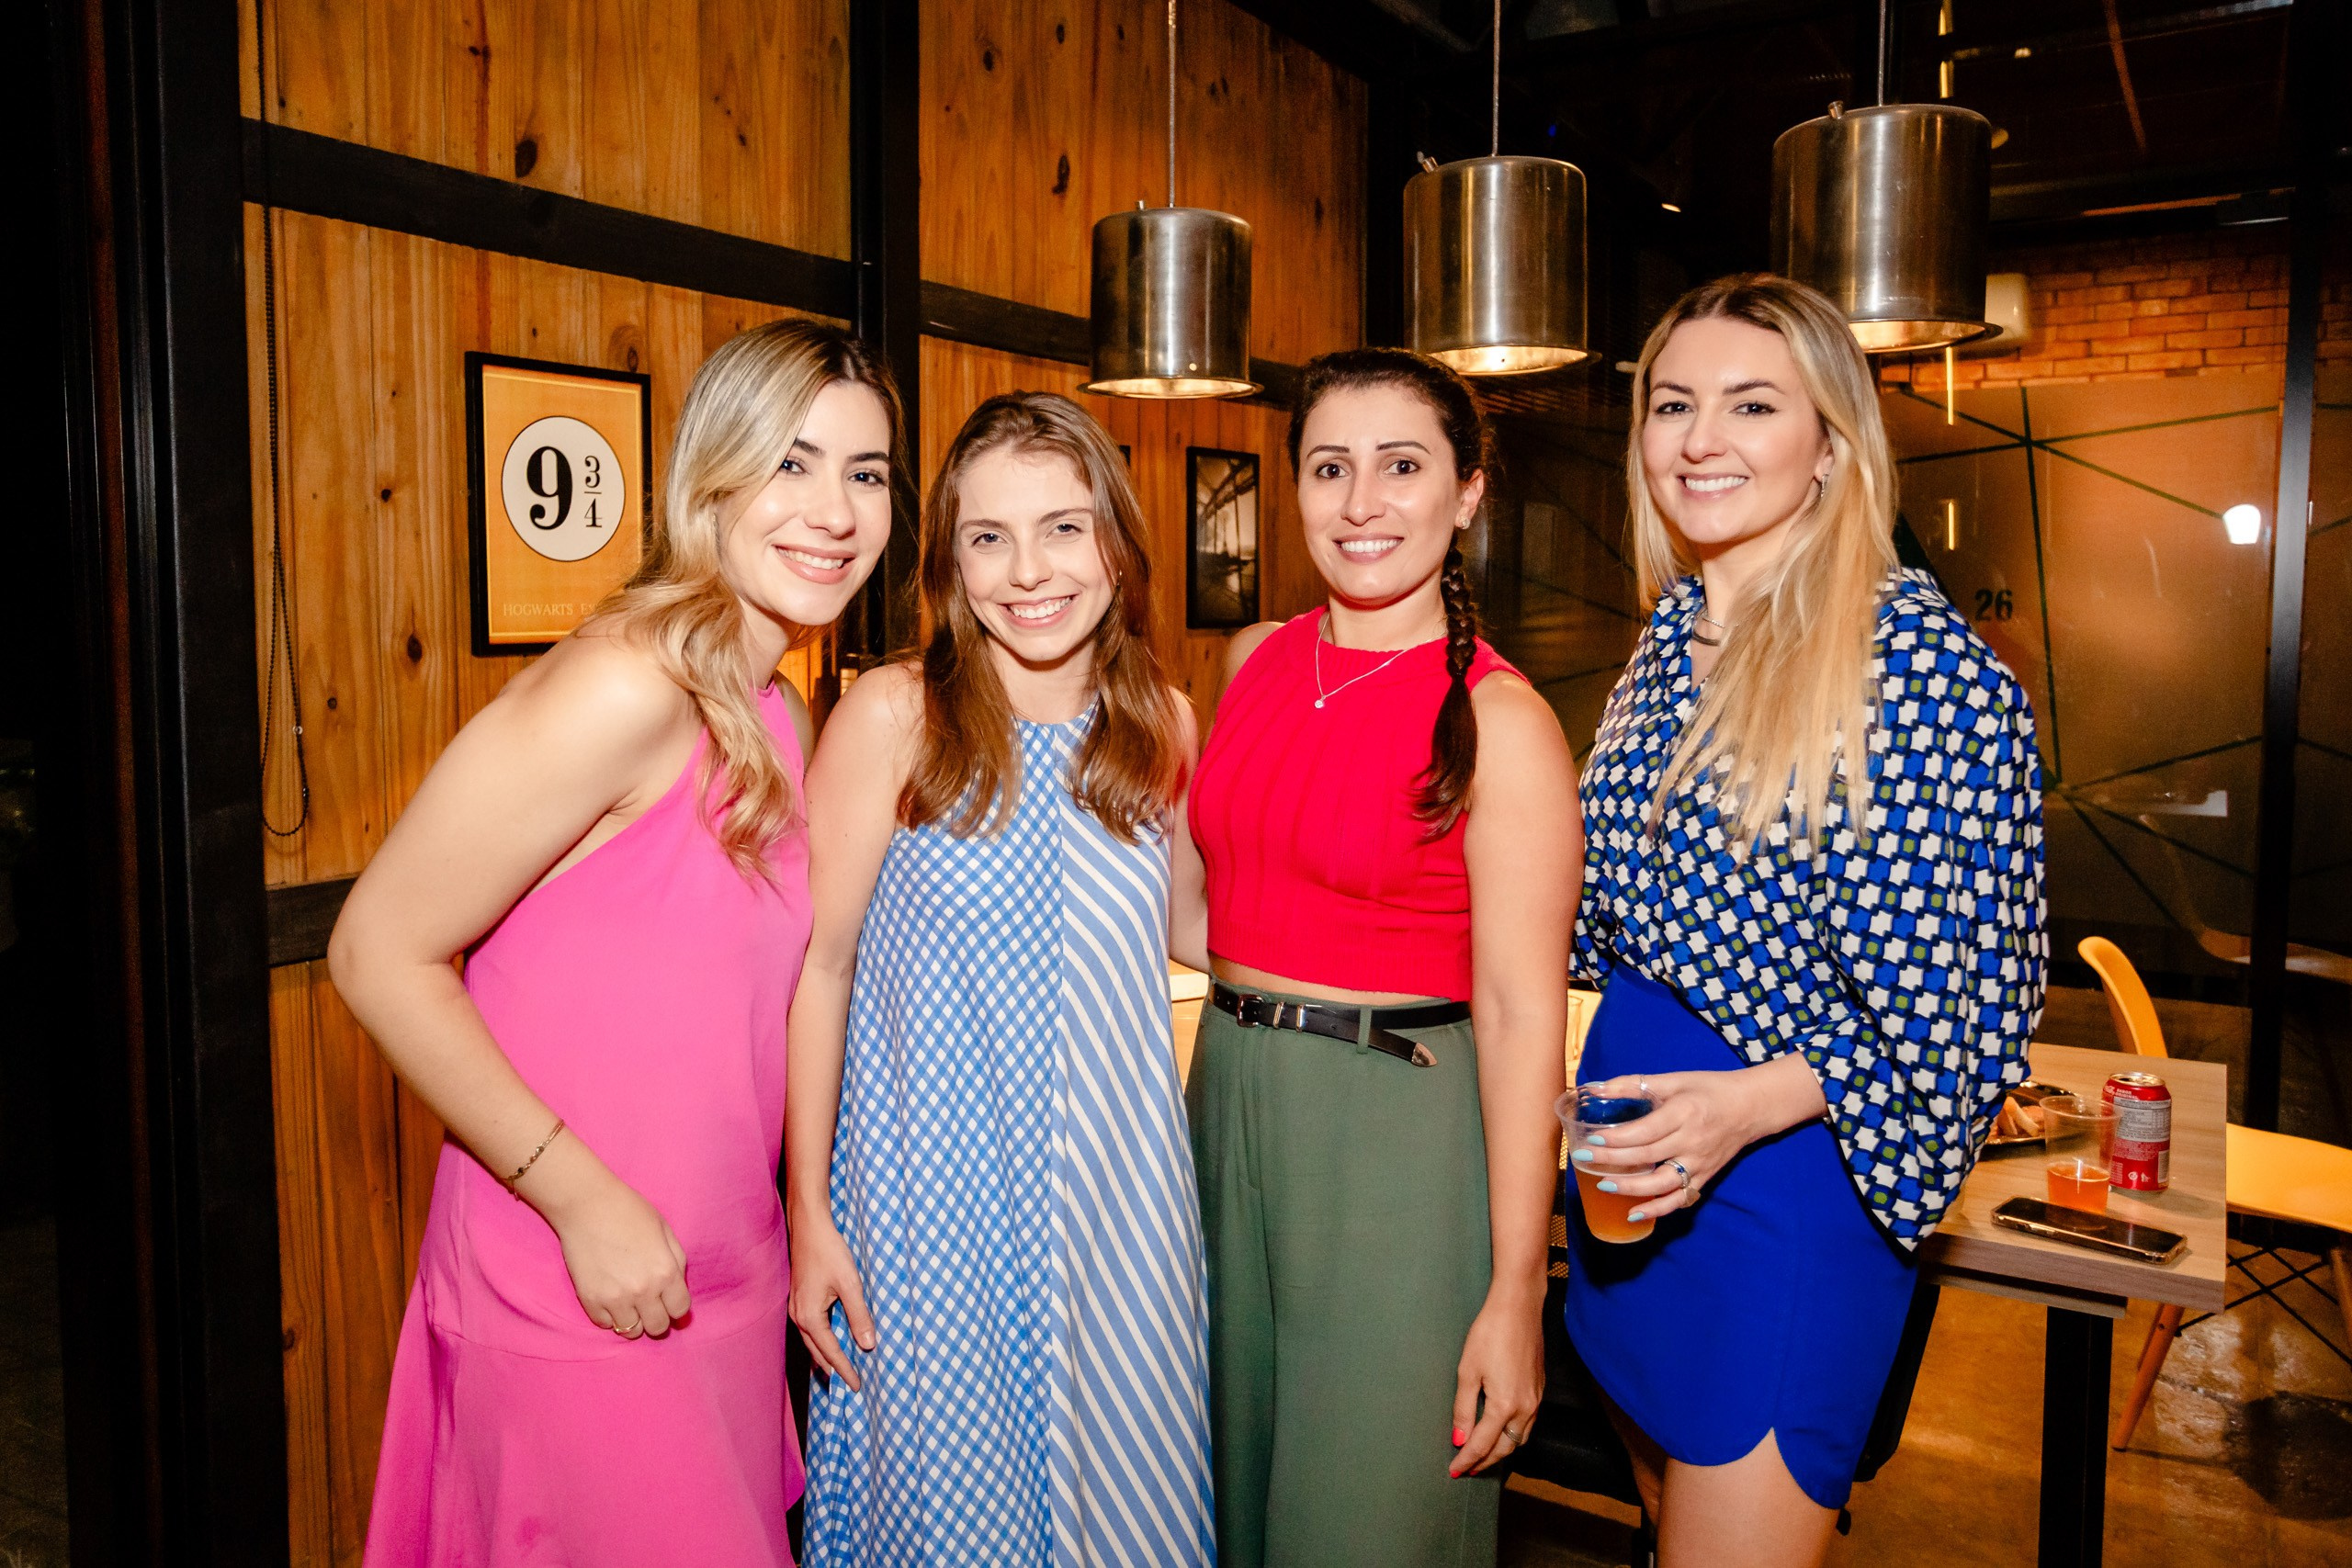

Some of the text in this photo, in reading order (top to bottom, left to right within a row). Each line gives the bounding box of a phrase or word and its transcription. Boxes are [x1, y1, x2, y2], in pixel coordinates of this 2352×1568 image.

[526, 446, 573, 531] 9
[503, 603, 574, 617] HOGWARTS
[1974, 588, 2013, 622] 26
